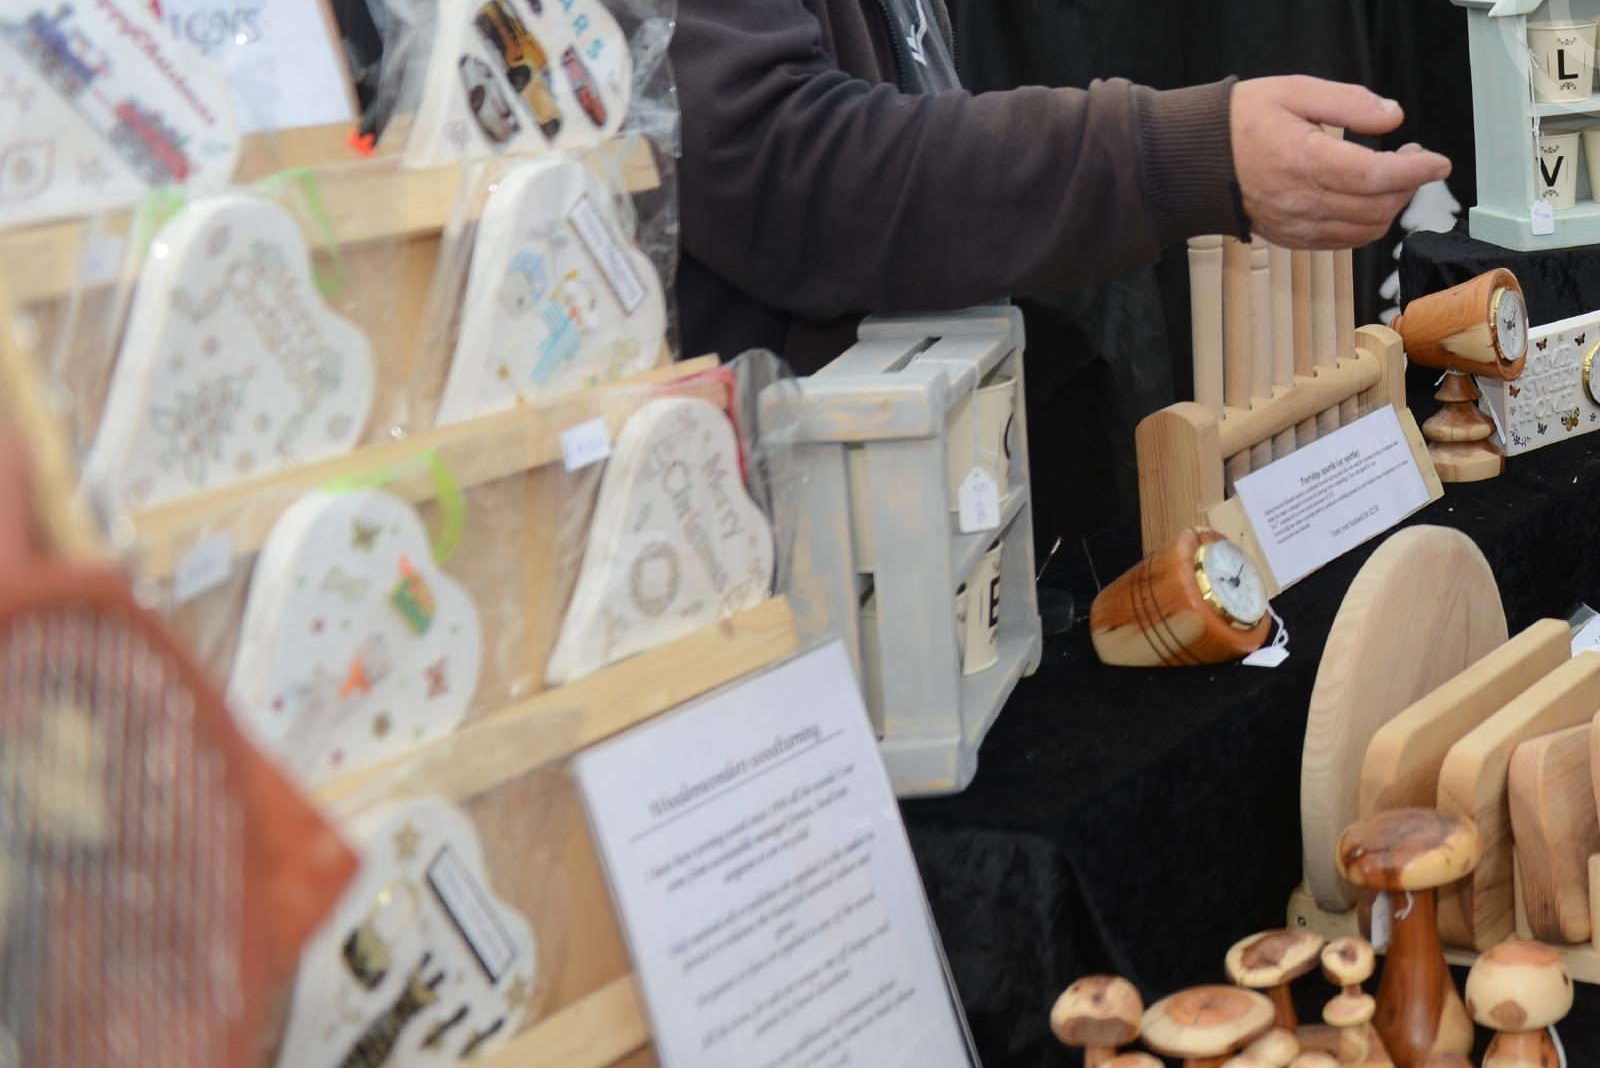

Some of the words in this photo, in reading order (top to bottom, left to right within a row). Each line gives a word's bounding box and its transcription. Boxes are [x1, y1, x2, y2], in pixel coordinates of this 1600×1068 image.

[170, 7, 262, 53] IGNS
[1557, 49, 1579, 80] L
[1536, 155, 1565, 187] V
[1519, 390, 1575, 424] HOME
